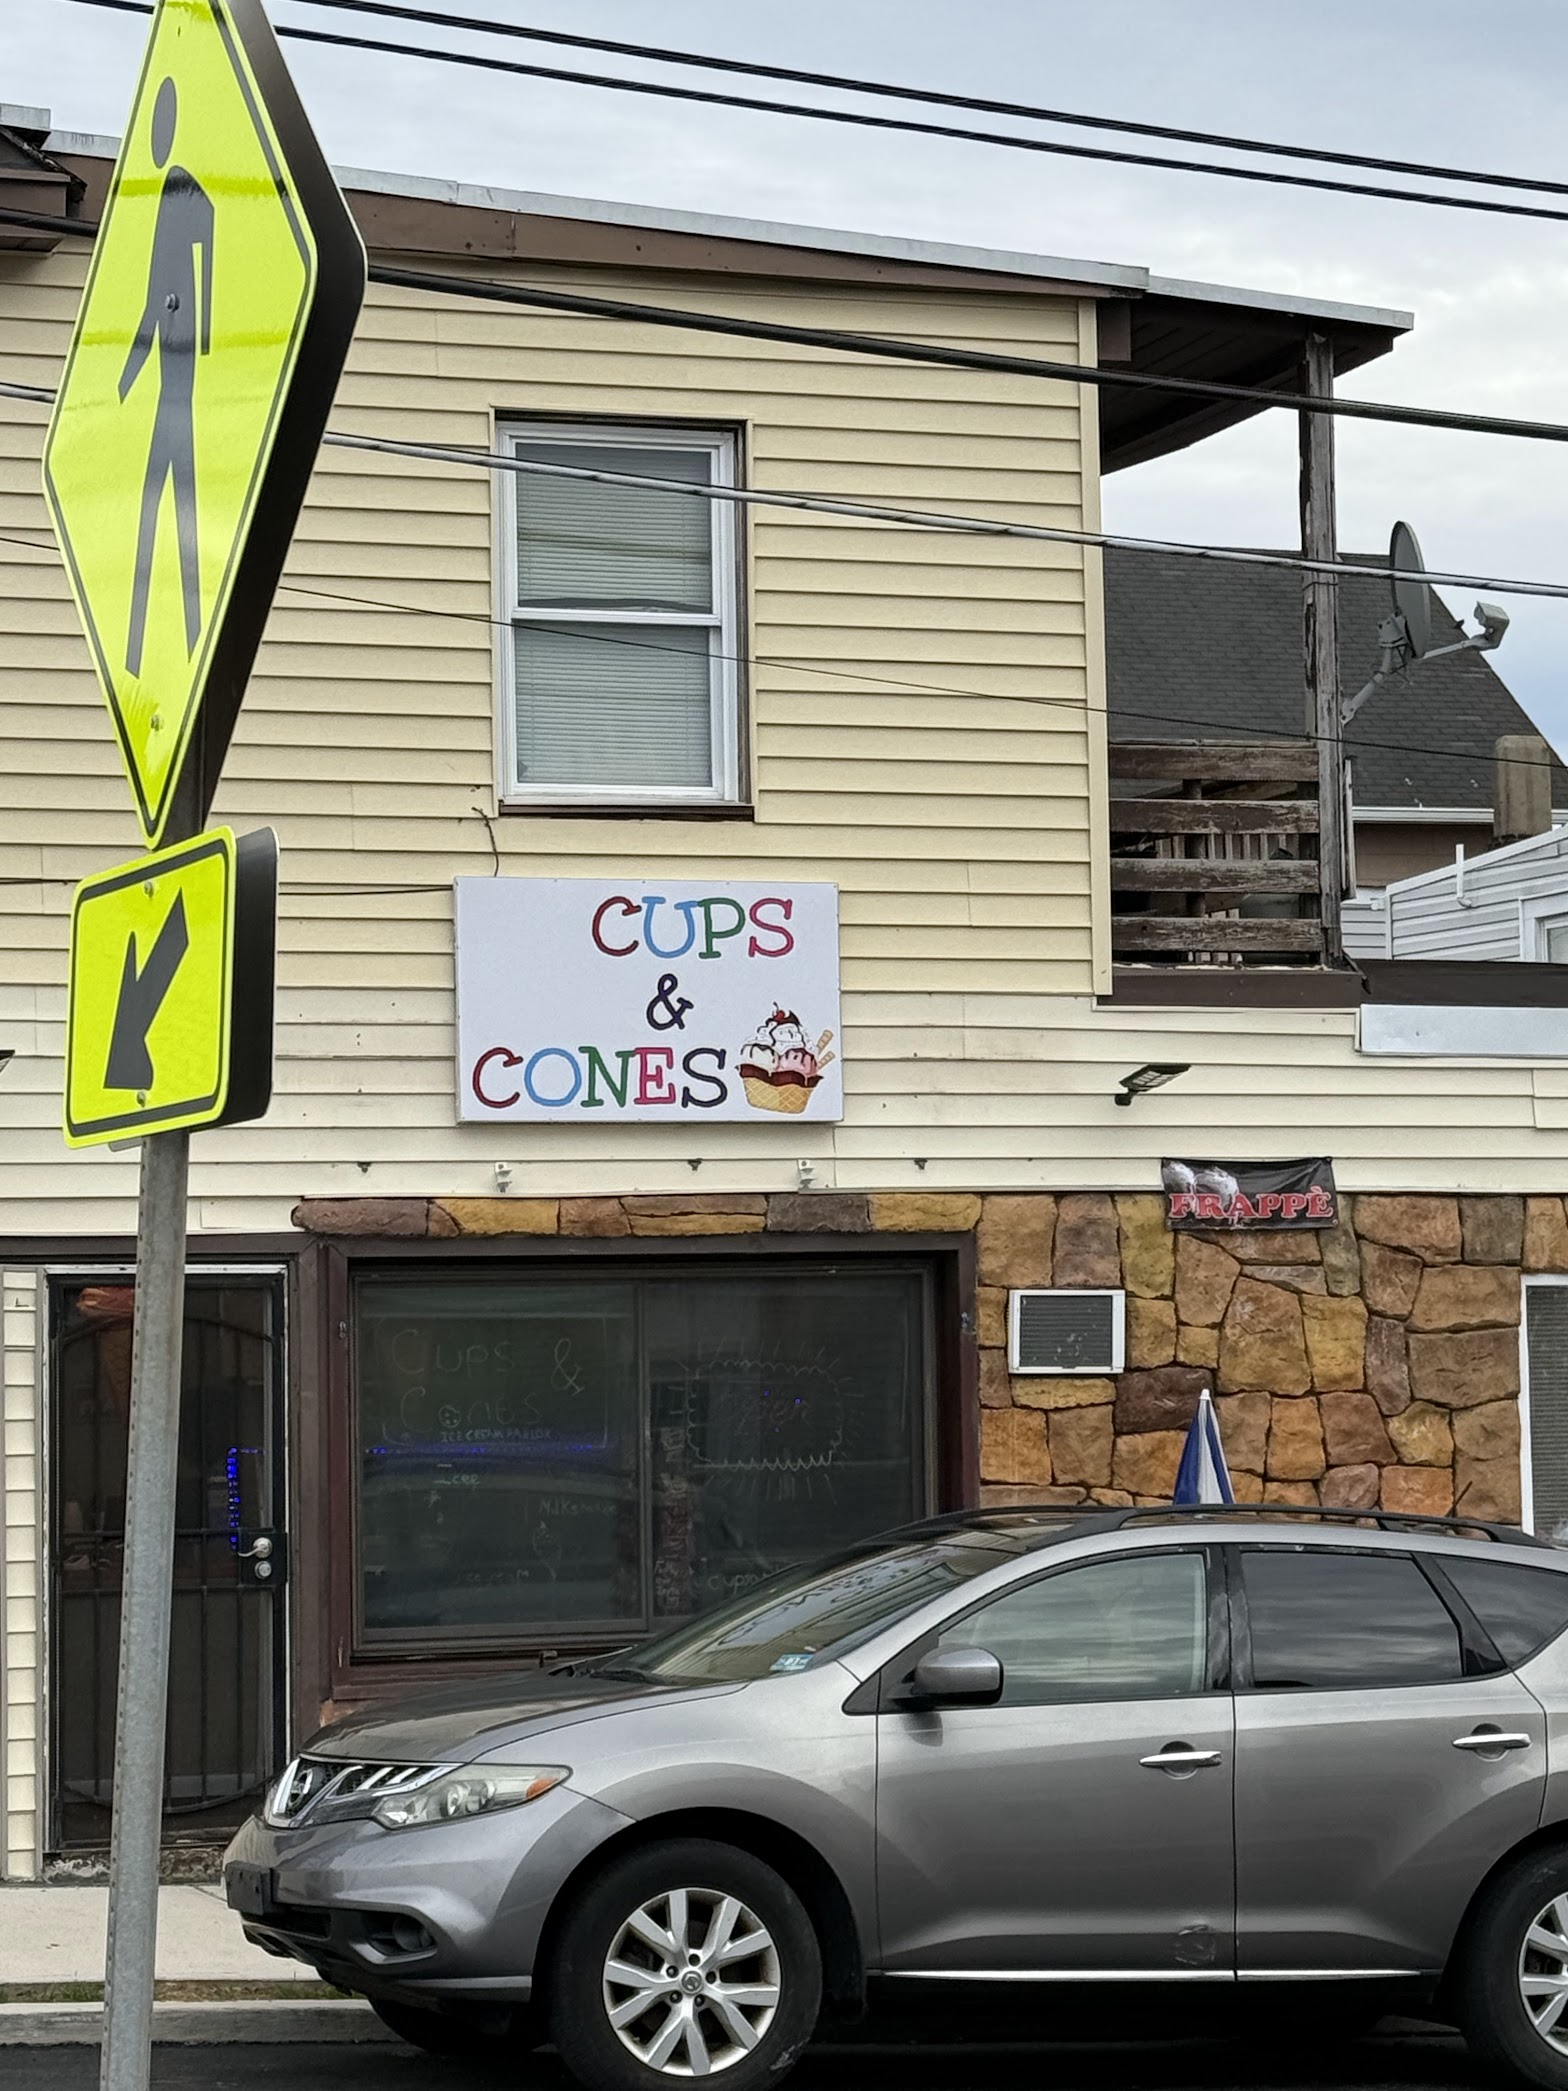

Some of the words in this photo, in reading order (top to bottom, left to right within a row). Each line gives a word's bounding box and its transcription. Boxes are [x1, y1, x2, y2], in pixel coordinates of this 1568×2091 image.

[592, 896, 794, 959] CUPS
[646, 973, 694, 1031] &
[472, 1046, 728, 1108] CONES
[550, 1337, 585, 1397] &
